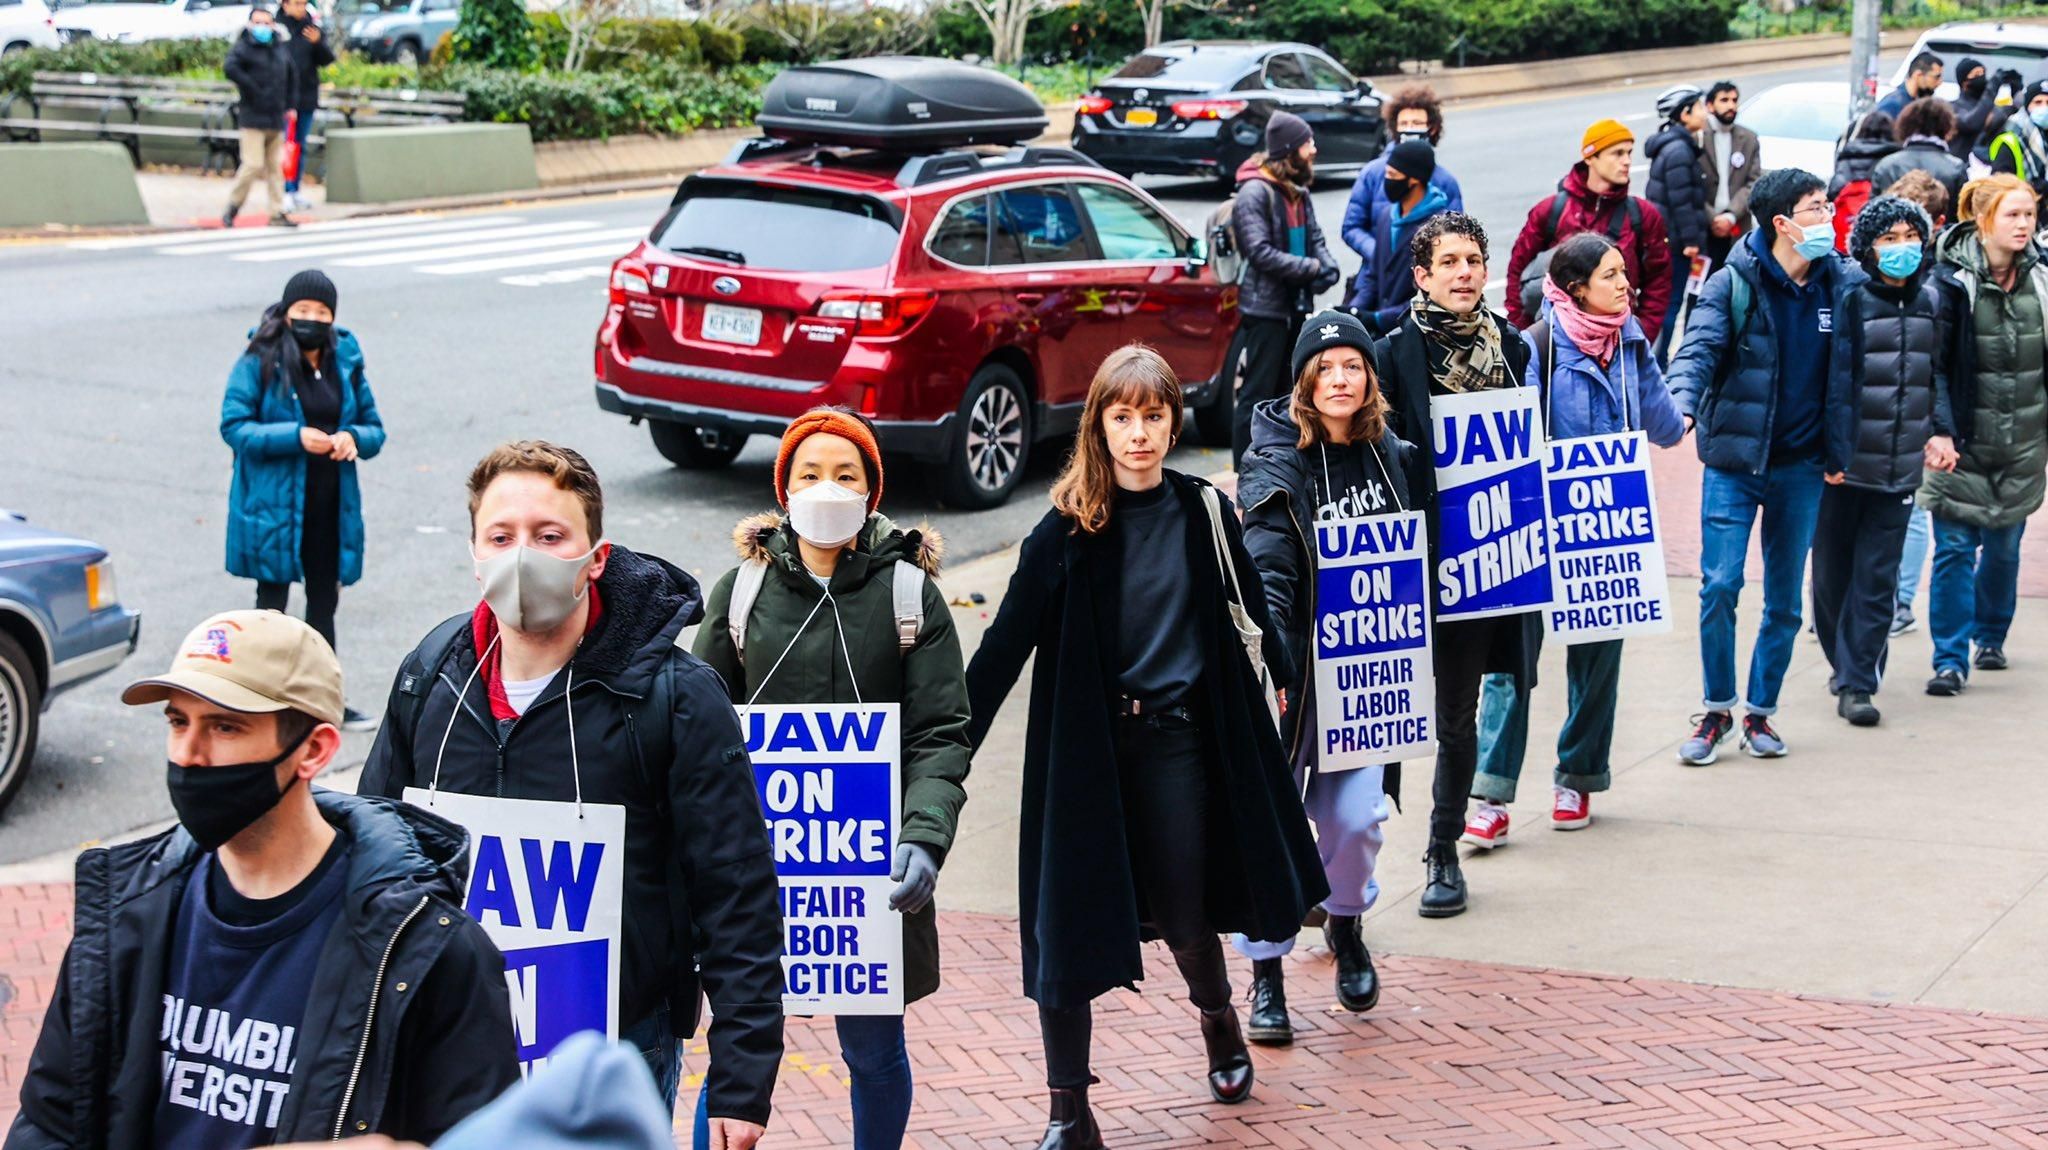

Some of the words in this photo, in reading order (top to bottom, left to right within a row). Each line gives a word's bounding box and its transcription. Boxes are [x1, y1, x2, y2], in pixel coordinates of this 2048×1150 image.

[1318, 479, 1387, 523] adid
[1467, 480, 1513, 541] ON
[1568, 476, 1614, 510] ON
[1318, 518, 1418, 560] UAW
[1437, 518, 1547, 607] STRIKE
[1558, 551, 1642, 580] UNFAIR
[1350, 566, 1392, 605] ON
[1567, 577, 1641, 605] LABOR
[1321, 603, 1423, 649] STRIKE
[1552, 600, 1662, 632] PRACTICE
[1337, 658, 1413, 691] UNFAIR
[1343, 688, 1411, 722] LABOR
[1326, 716, 1428, 755] PRACTICE
[765, 768, 834, 815] ON
[766, 817, 886, 864] RIKE
[465, 835, 605, 932] AW
[779, 886, 866, 918] FAIR
[783, 924, 859, 957] BOR
[783, 963, 889, 995] CTICE
[504, 964, 537, 1047] N
[160, 993, 297, 1075] LUMBI
